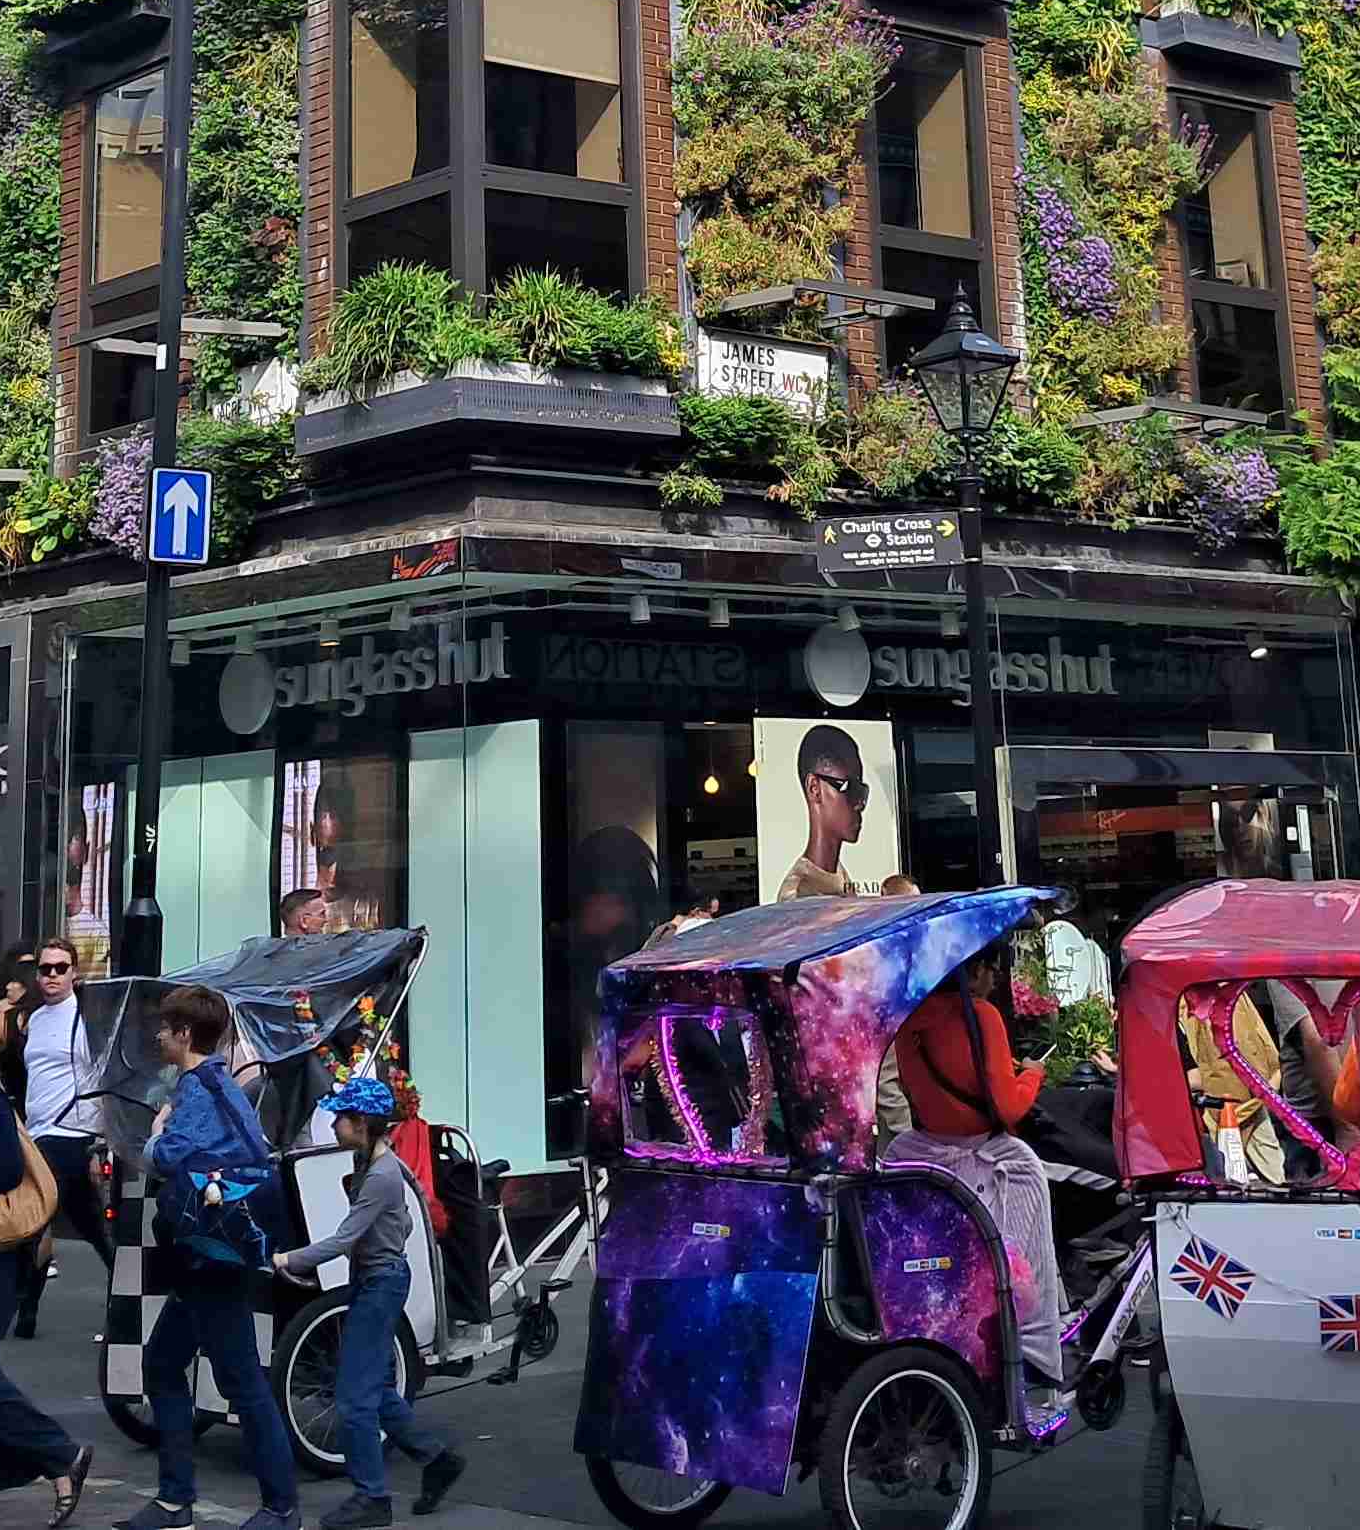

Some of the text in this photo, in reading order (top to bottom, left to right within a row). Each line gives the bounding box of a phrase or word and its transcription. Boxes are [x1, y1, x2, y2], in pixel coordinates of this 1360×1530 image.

[721, 341, 775, 367] JAMES
[721, 364, 775, 390] STREET
[841, 518, 933, 534] Charing Cross
[886, 532, 934, 546] Station
